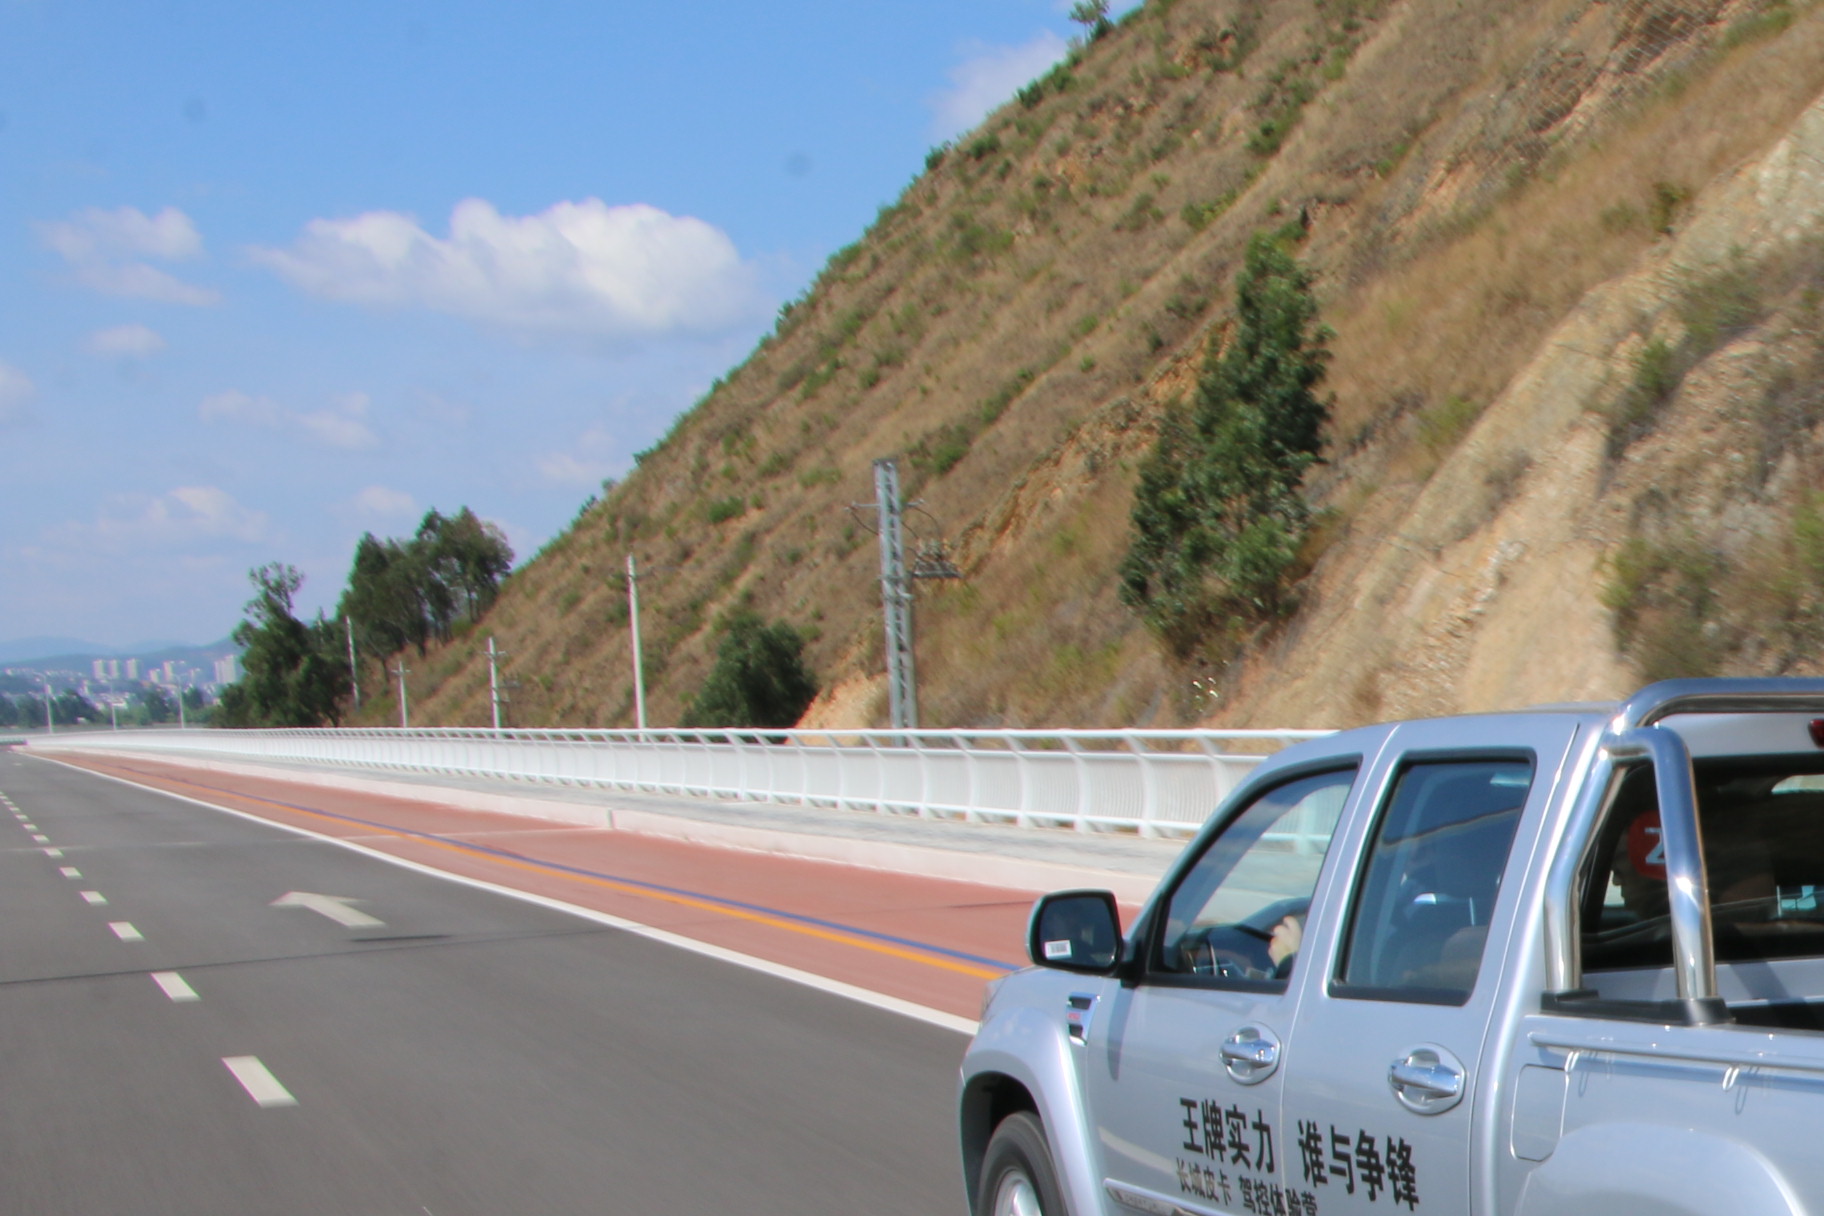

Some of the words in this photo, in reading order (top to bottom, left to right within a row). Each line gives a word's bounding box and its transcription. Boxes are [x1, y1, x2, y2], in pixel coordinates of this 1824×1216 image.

[1180, 1097, 1275, 1173] 王牌实力
[1297, 1119, 1419, 1211] 谁与争锋
